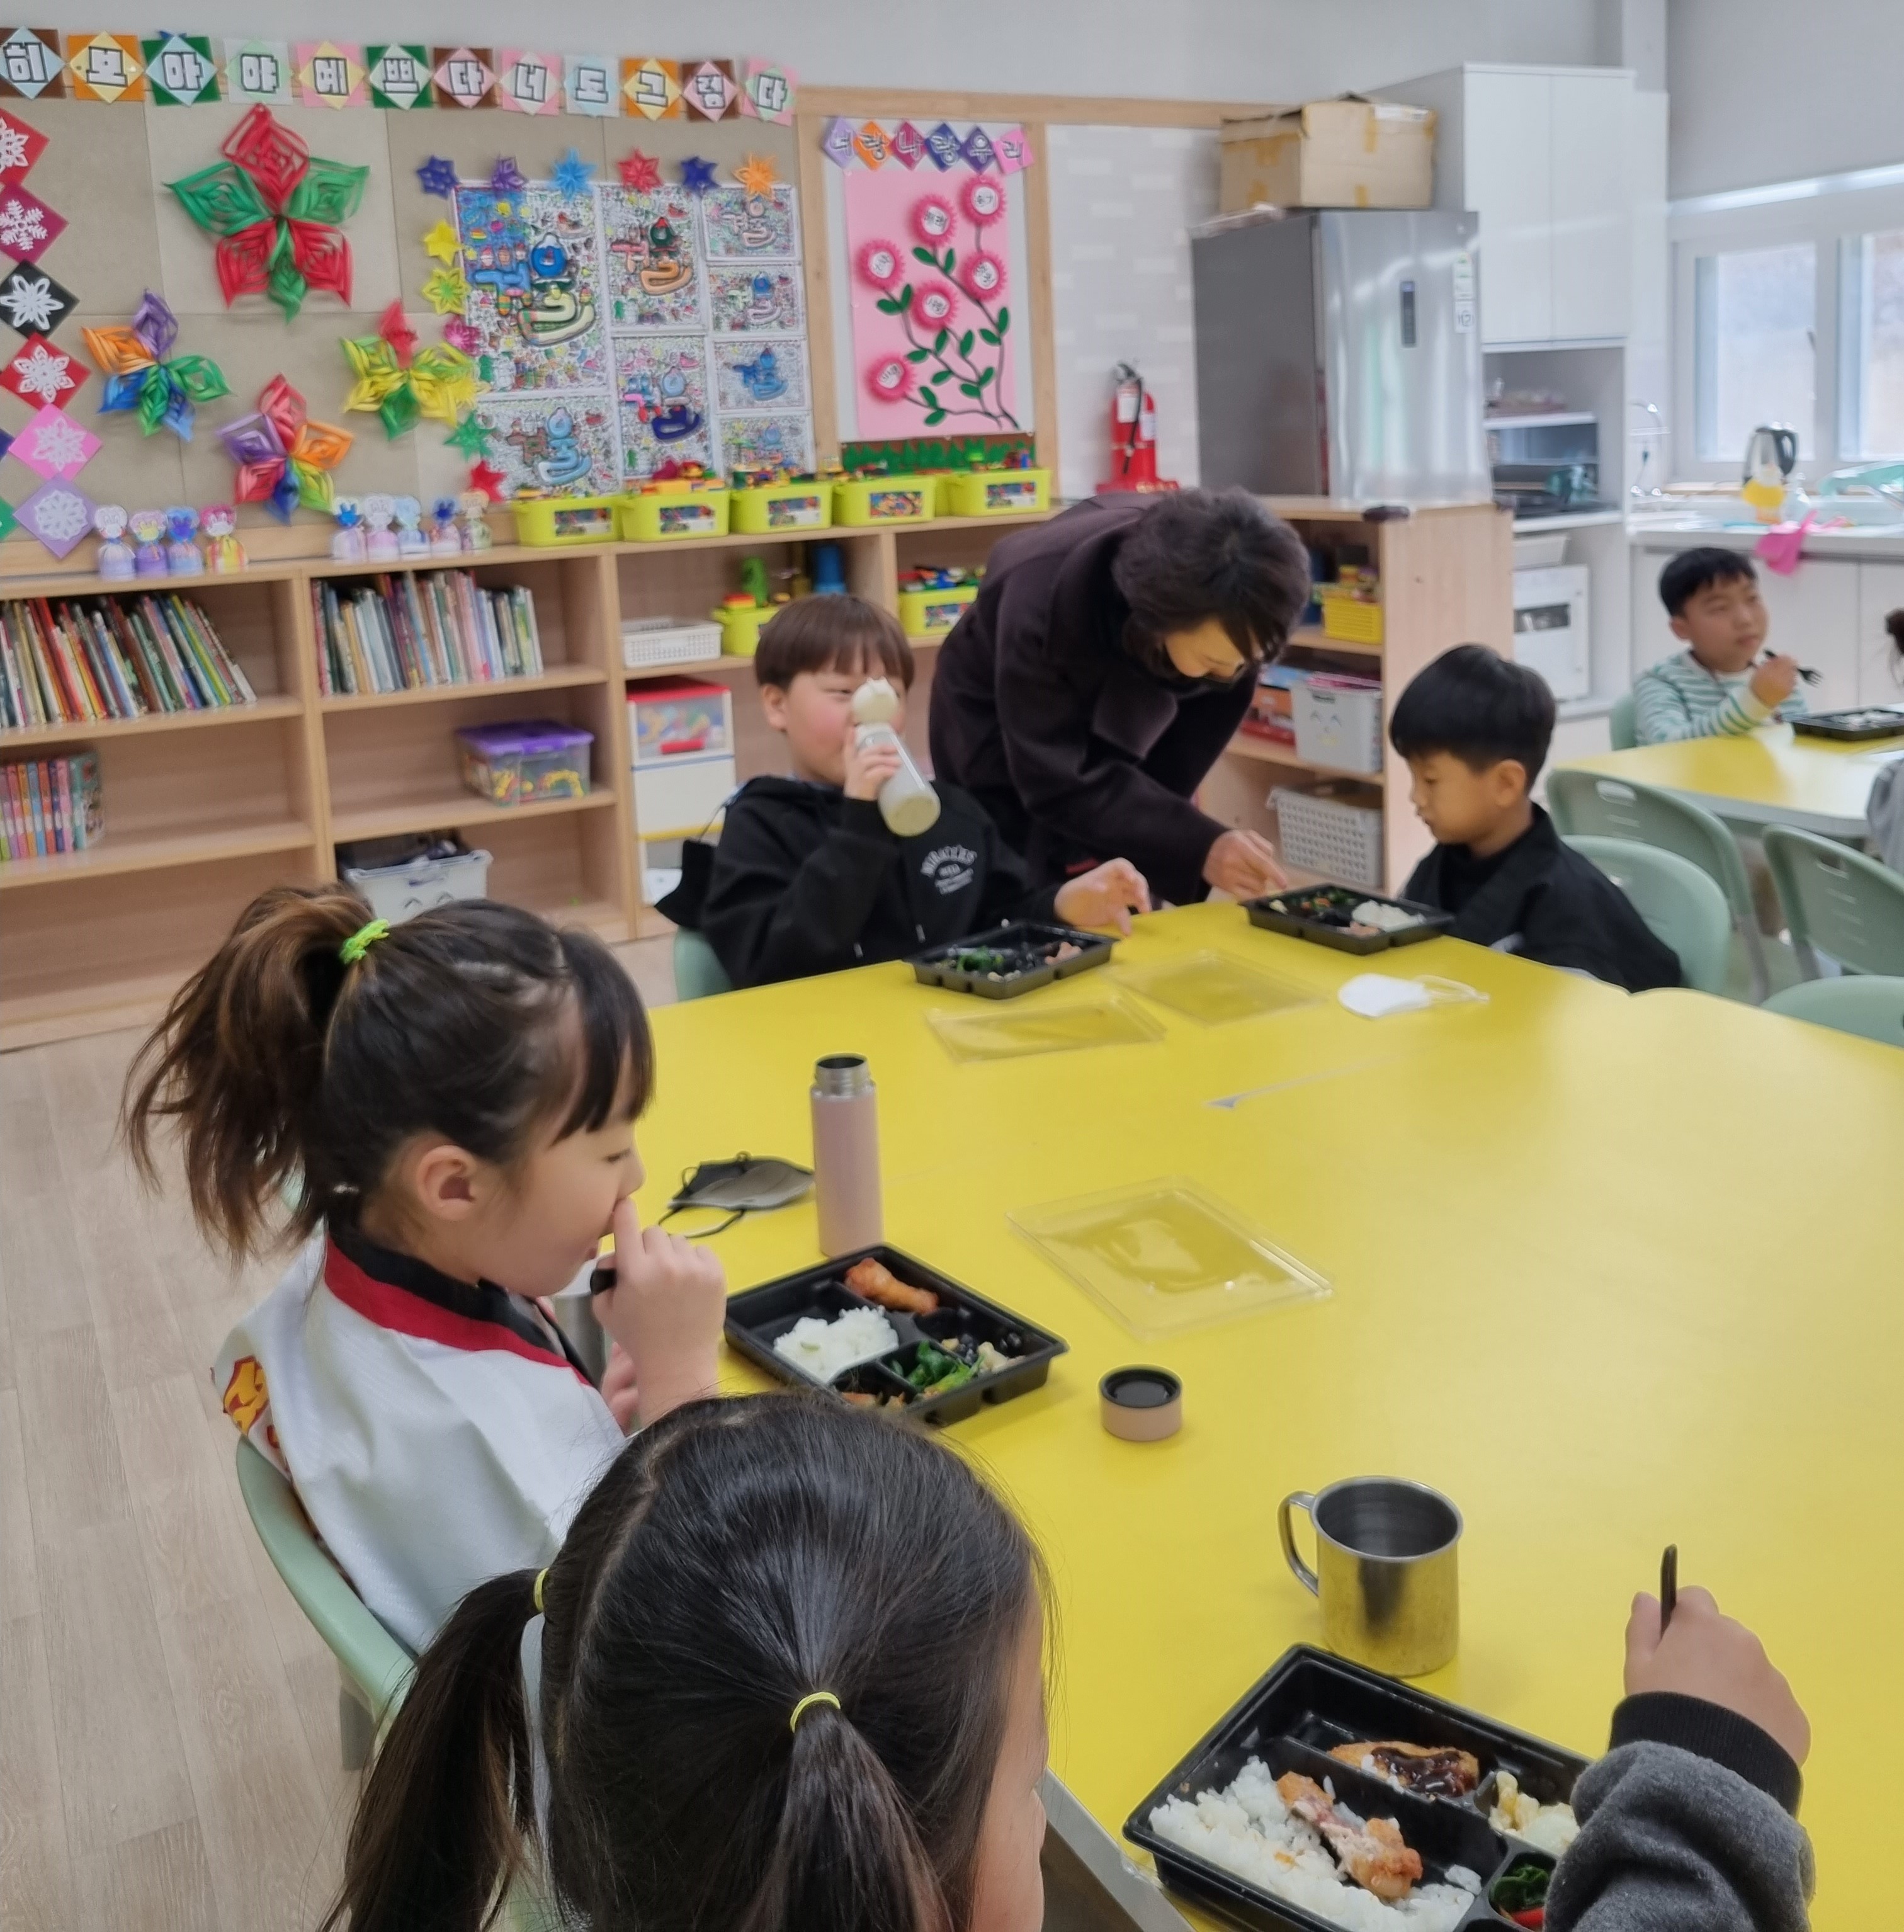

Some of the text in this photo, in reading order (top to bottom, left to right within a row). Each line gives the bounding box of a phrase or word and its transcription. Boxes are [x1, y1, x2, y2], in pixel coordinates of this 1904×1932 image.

[3, 41, 48, 84] 히
[473, 232, 597, 346] 겨울
[610, 217, 693, 296] 겨울
